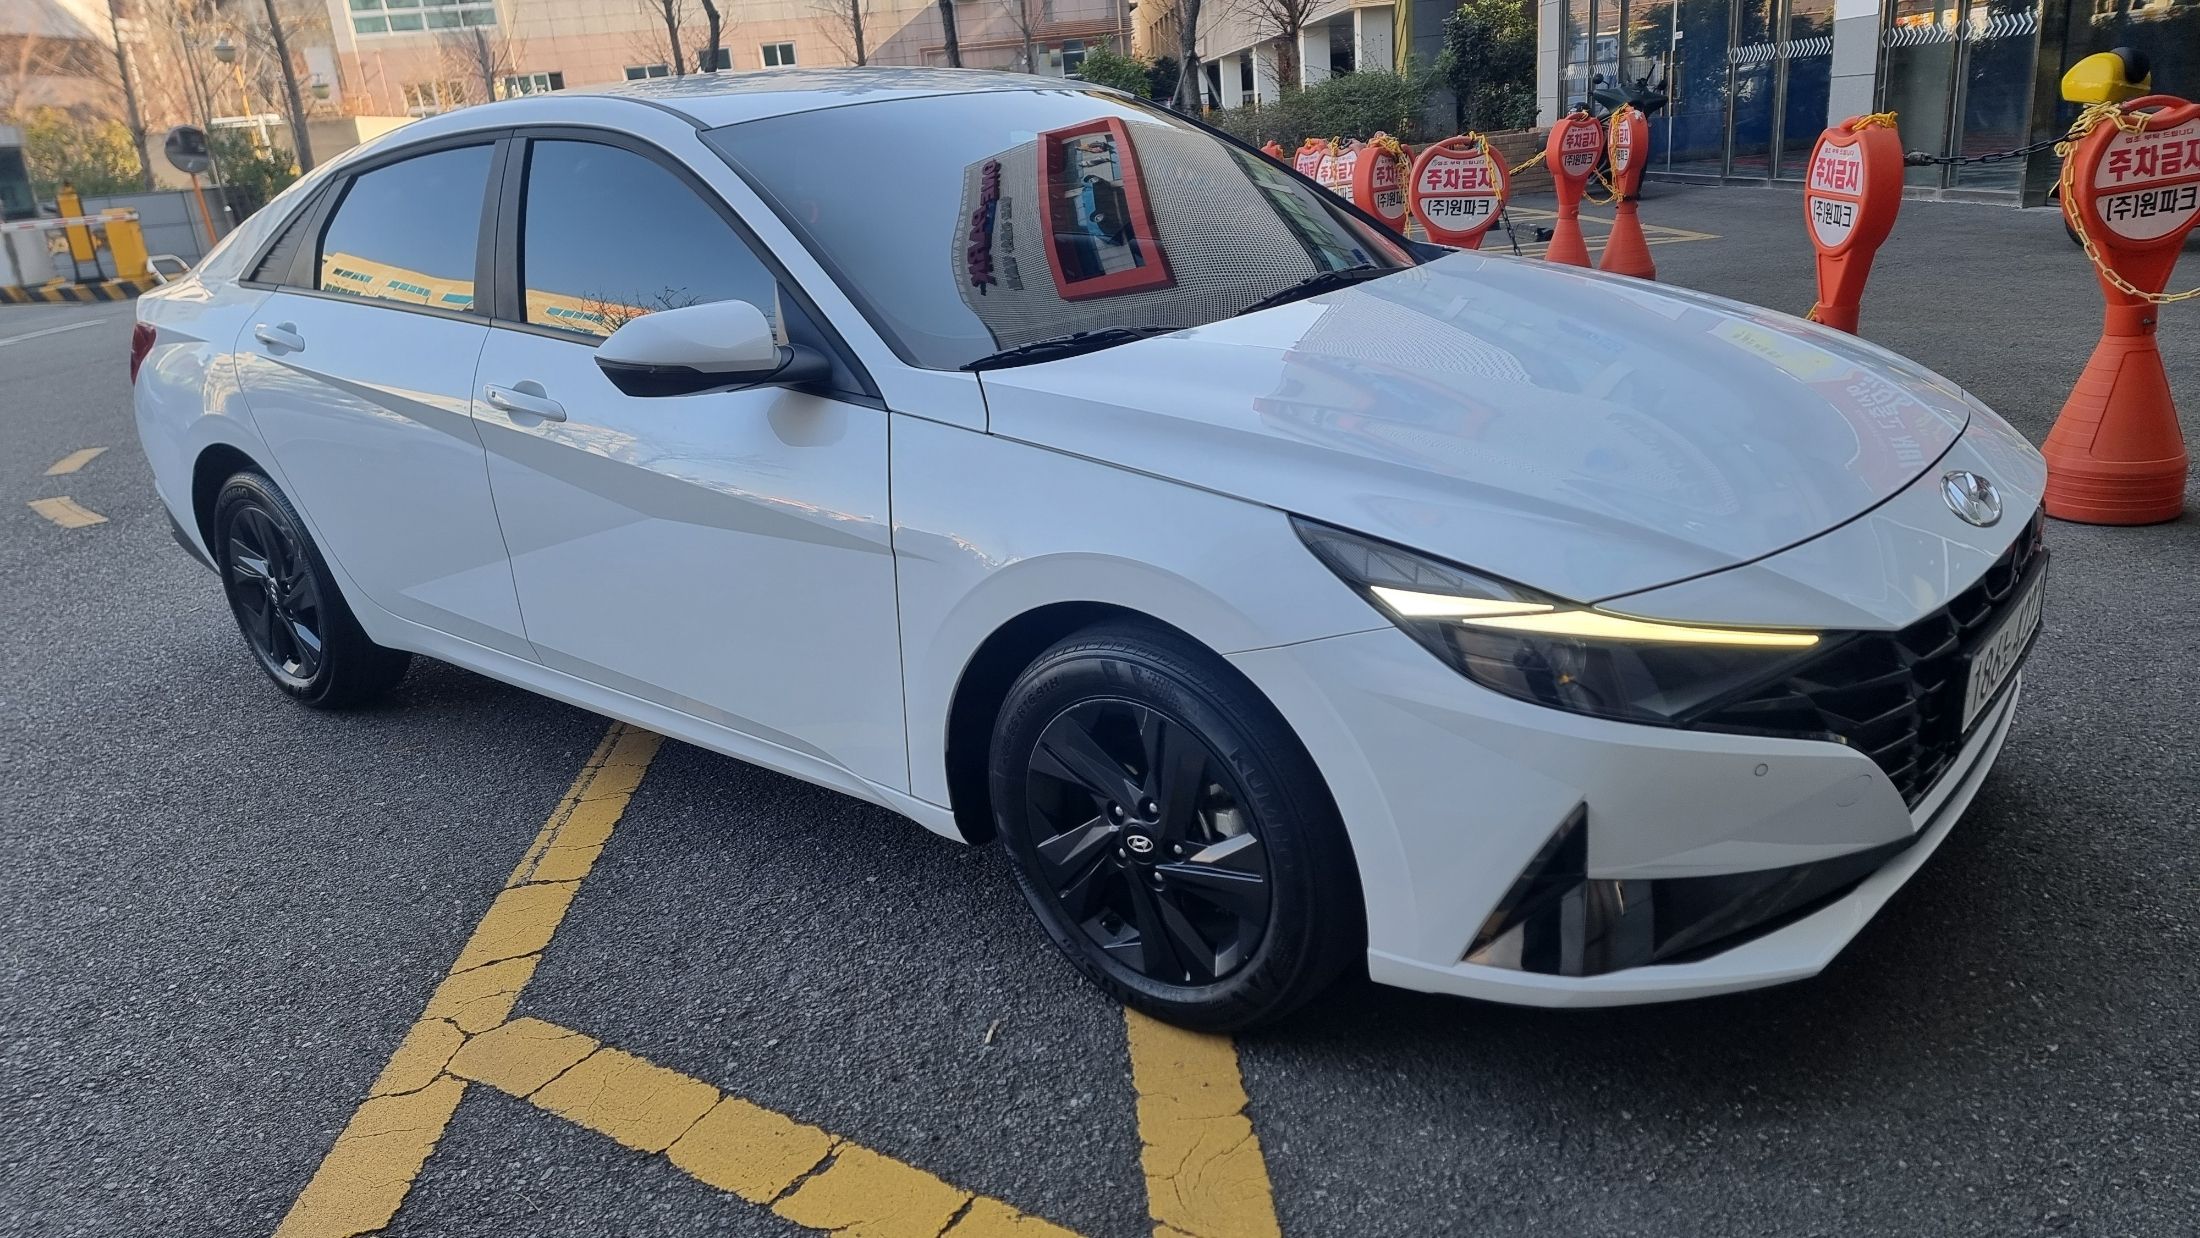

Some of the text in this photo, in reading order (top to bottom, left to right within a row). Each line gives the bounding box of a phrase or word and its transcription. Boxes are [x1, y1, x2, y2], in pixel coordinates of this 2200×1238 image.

[1566, 132, 1597, 149] 주차금지
[2162, 128, 2194, 138] 드립니다
[1564, 153, 1593, 166] (주)원파크
[1816, 157, 1860, 191] 주차금지
[1377, 190, 1405, 208] (주)원파
[1427, 199, 1490, 216] (주)원파크
[2106, 186, 2198, 221] (주)원파크
[1813, 200, 1852, 227] (주)원파크
